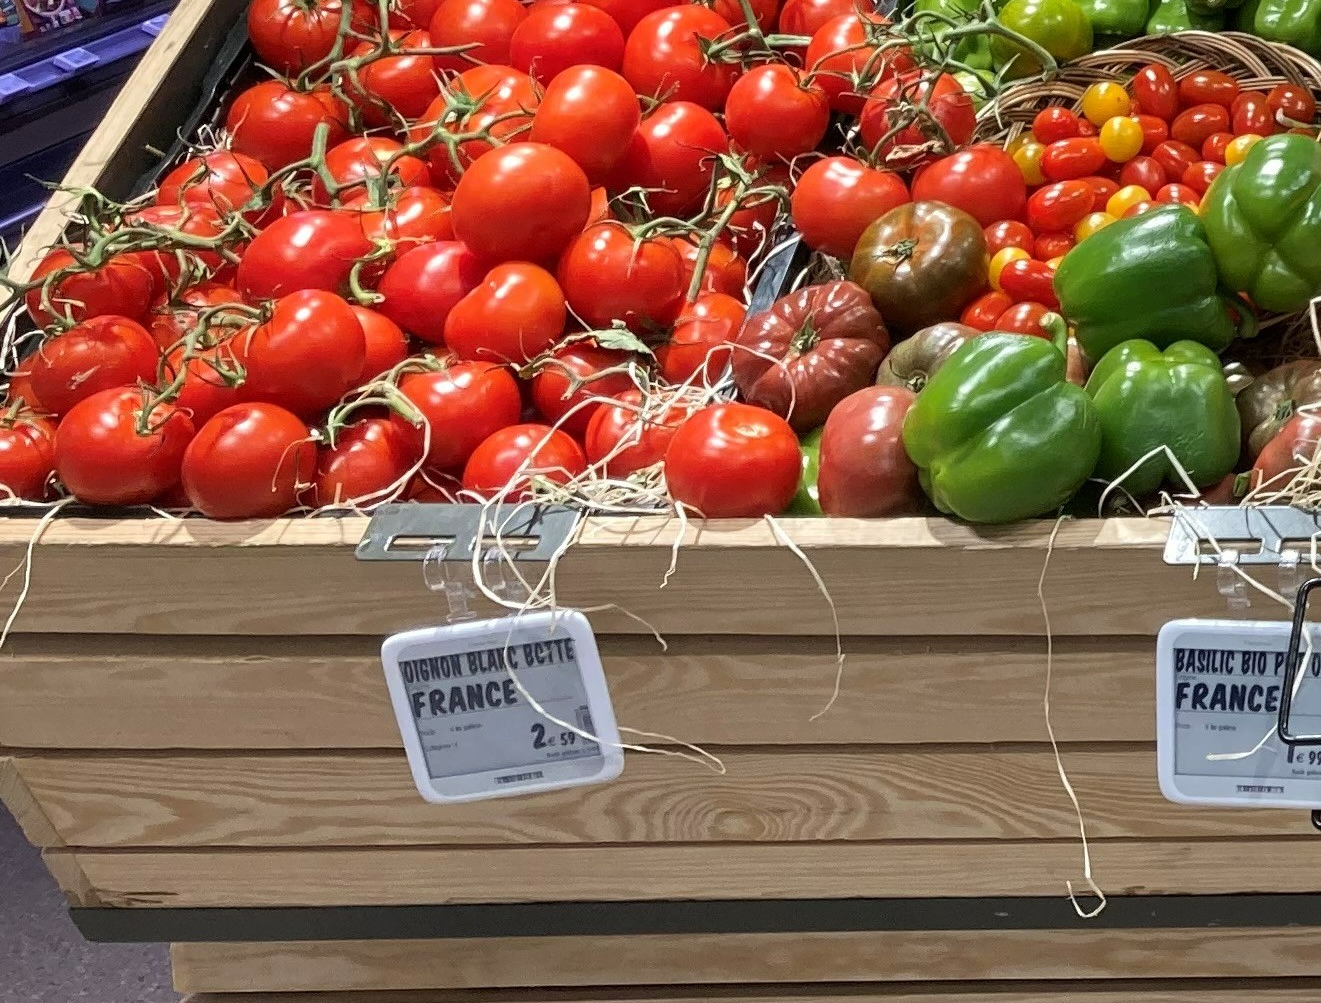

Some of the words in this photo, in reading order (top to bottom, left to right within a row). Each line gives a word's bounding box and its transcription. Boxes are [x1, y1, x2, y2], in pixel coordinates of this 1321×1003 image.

[403, 653, 463, 684] OIGNON
[1175, 648, 1235, 675] BASILIC
[1241, 651, 1267, 676] BIO
[412, 678, 518, 718] FRANCE
[1175, 682, 1281, 712] FRANCE
